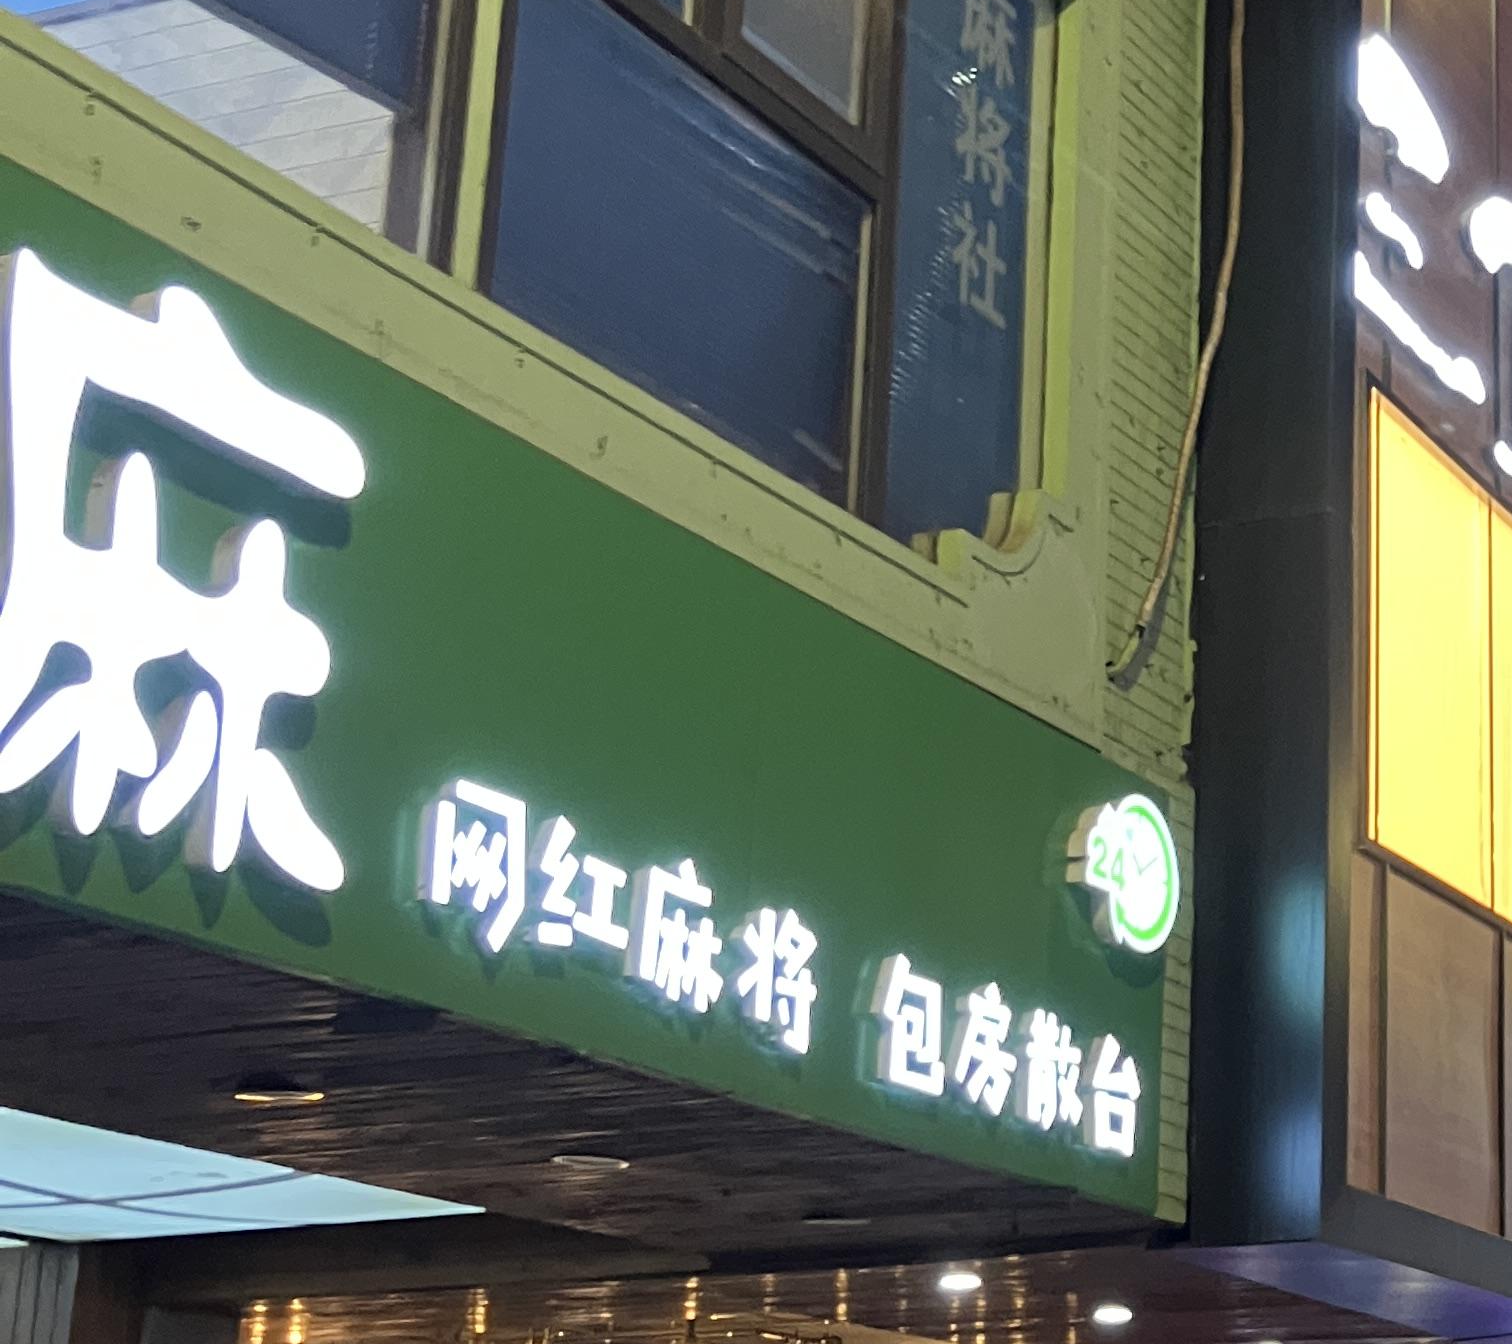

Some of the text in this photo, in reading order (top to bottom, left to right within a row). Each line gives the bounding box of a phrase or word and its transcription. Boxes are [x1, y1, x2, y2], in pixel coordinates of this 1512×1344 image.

[0, 247, 366, 893] 麻
[432, 777, 1143, 1156] 网红麻将 包房散台
[1093, 835, 1126, 889] 24
